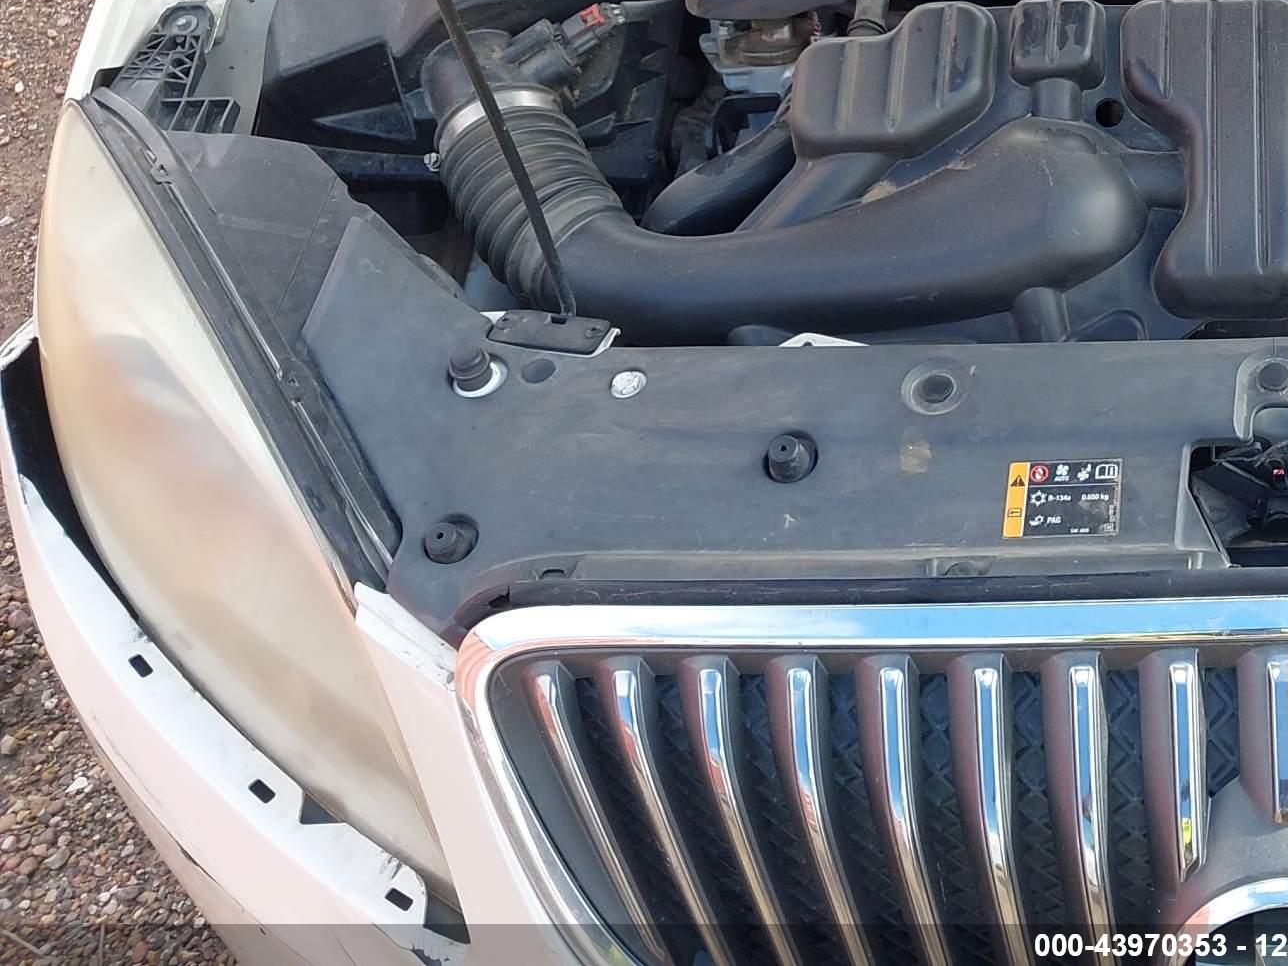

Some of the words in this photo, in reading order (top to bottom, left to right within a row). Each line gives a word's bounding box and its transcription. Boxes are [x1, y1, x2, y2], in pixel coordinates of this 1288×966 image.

[1047, 493, 1072, 501] R-134a
[1100, 492, 1110, 501] kg
[1046, 515, 1062, 524] PAG
